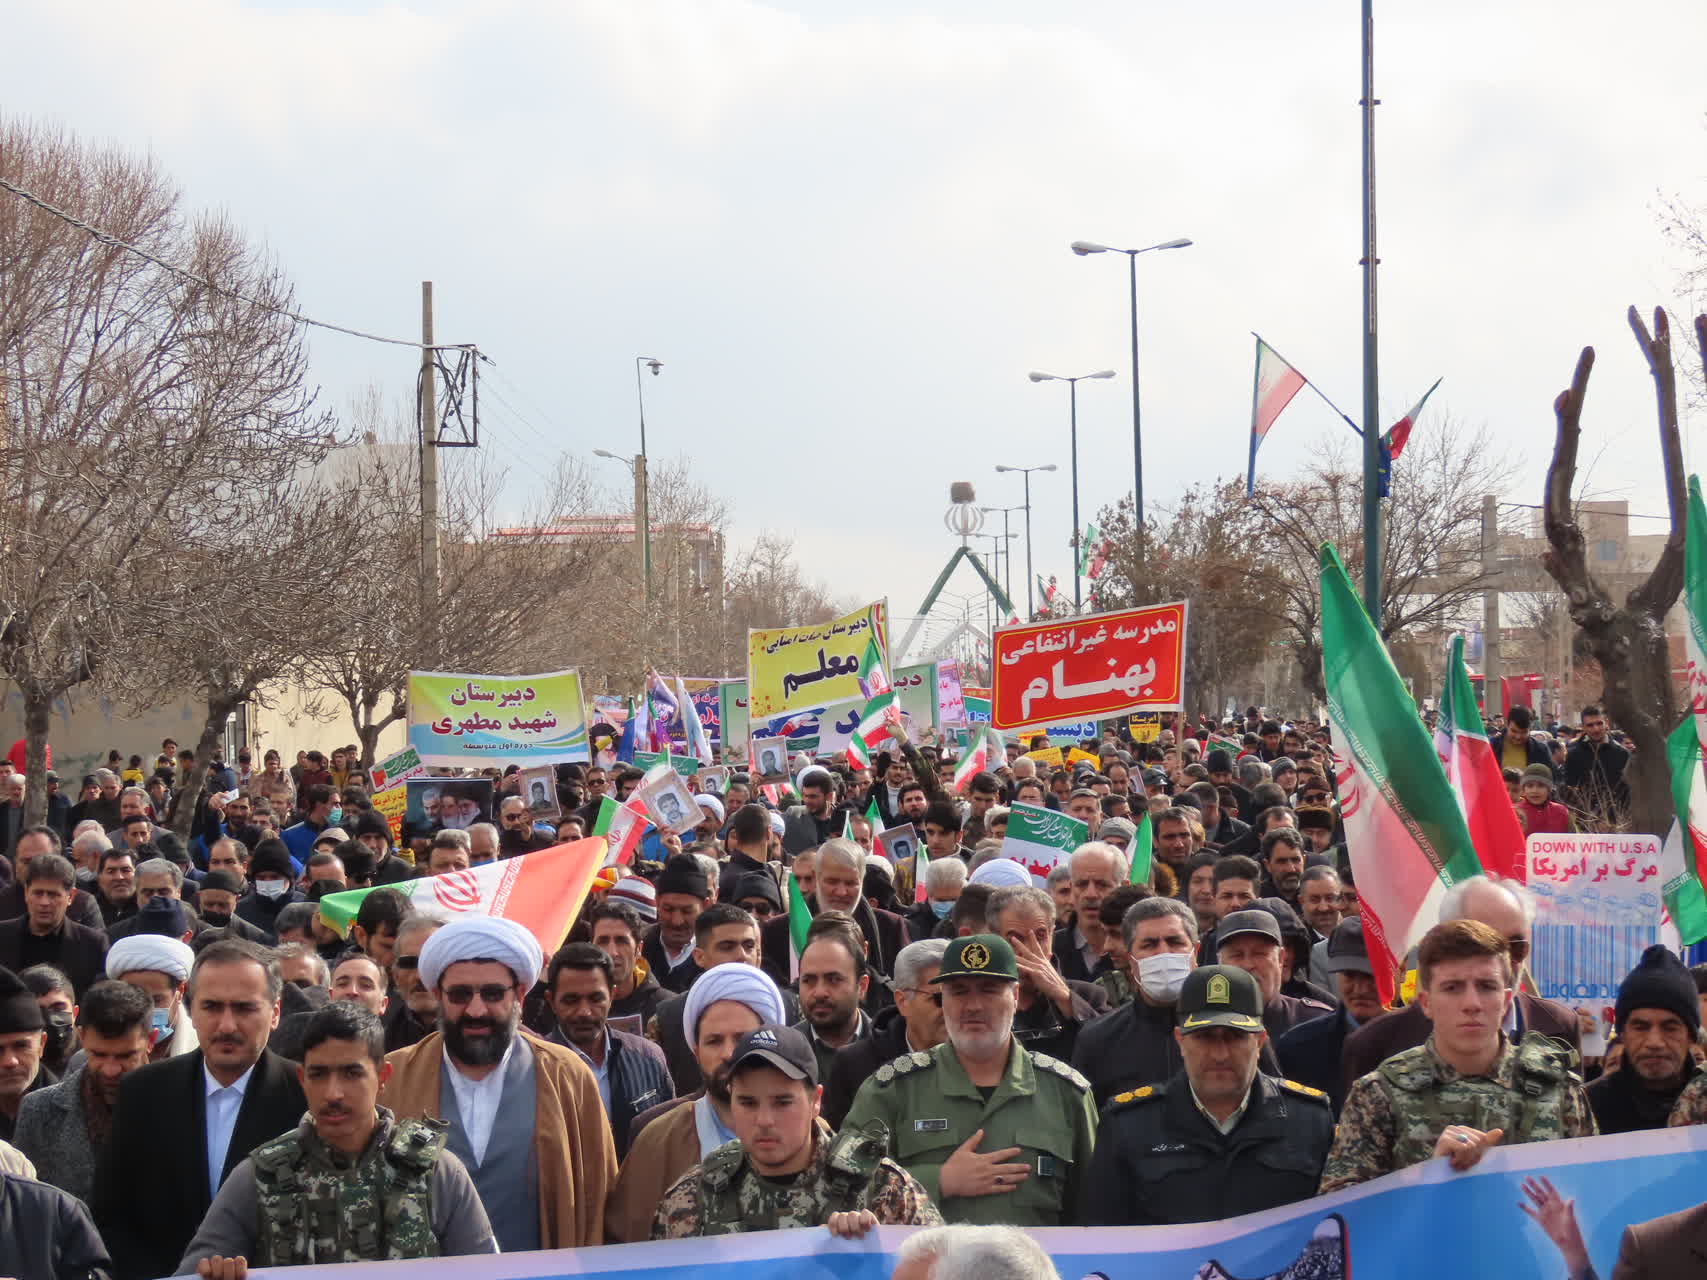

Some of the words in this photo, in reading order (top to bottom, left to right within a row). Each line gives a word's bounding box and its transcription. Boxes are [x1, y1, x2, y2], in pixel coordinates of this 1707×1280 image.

[1073, 624, 1109, 654] غیر
[1113, 618, 1177, 644] مدرسه
[1001, 628, 1075, 666] انتفاعی
[783, 648, 859, 699] معلم
[451, 682, 536, 708] دبیرستان
[1021, 657, 1157, 720] بهنام
[431, 711, 502, 736] مطهری
[508, 710, 557, 735] شهید
[1532, 842, 1576, 854] DOWN
[1580, 842, 1616, 854] WITH
[1620, 842, 1657, 854] U.S.A
[1591, 863, 1609, 882] بر
[1614, 857, 1658, 883] مرگ
